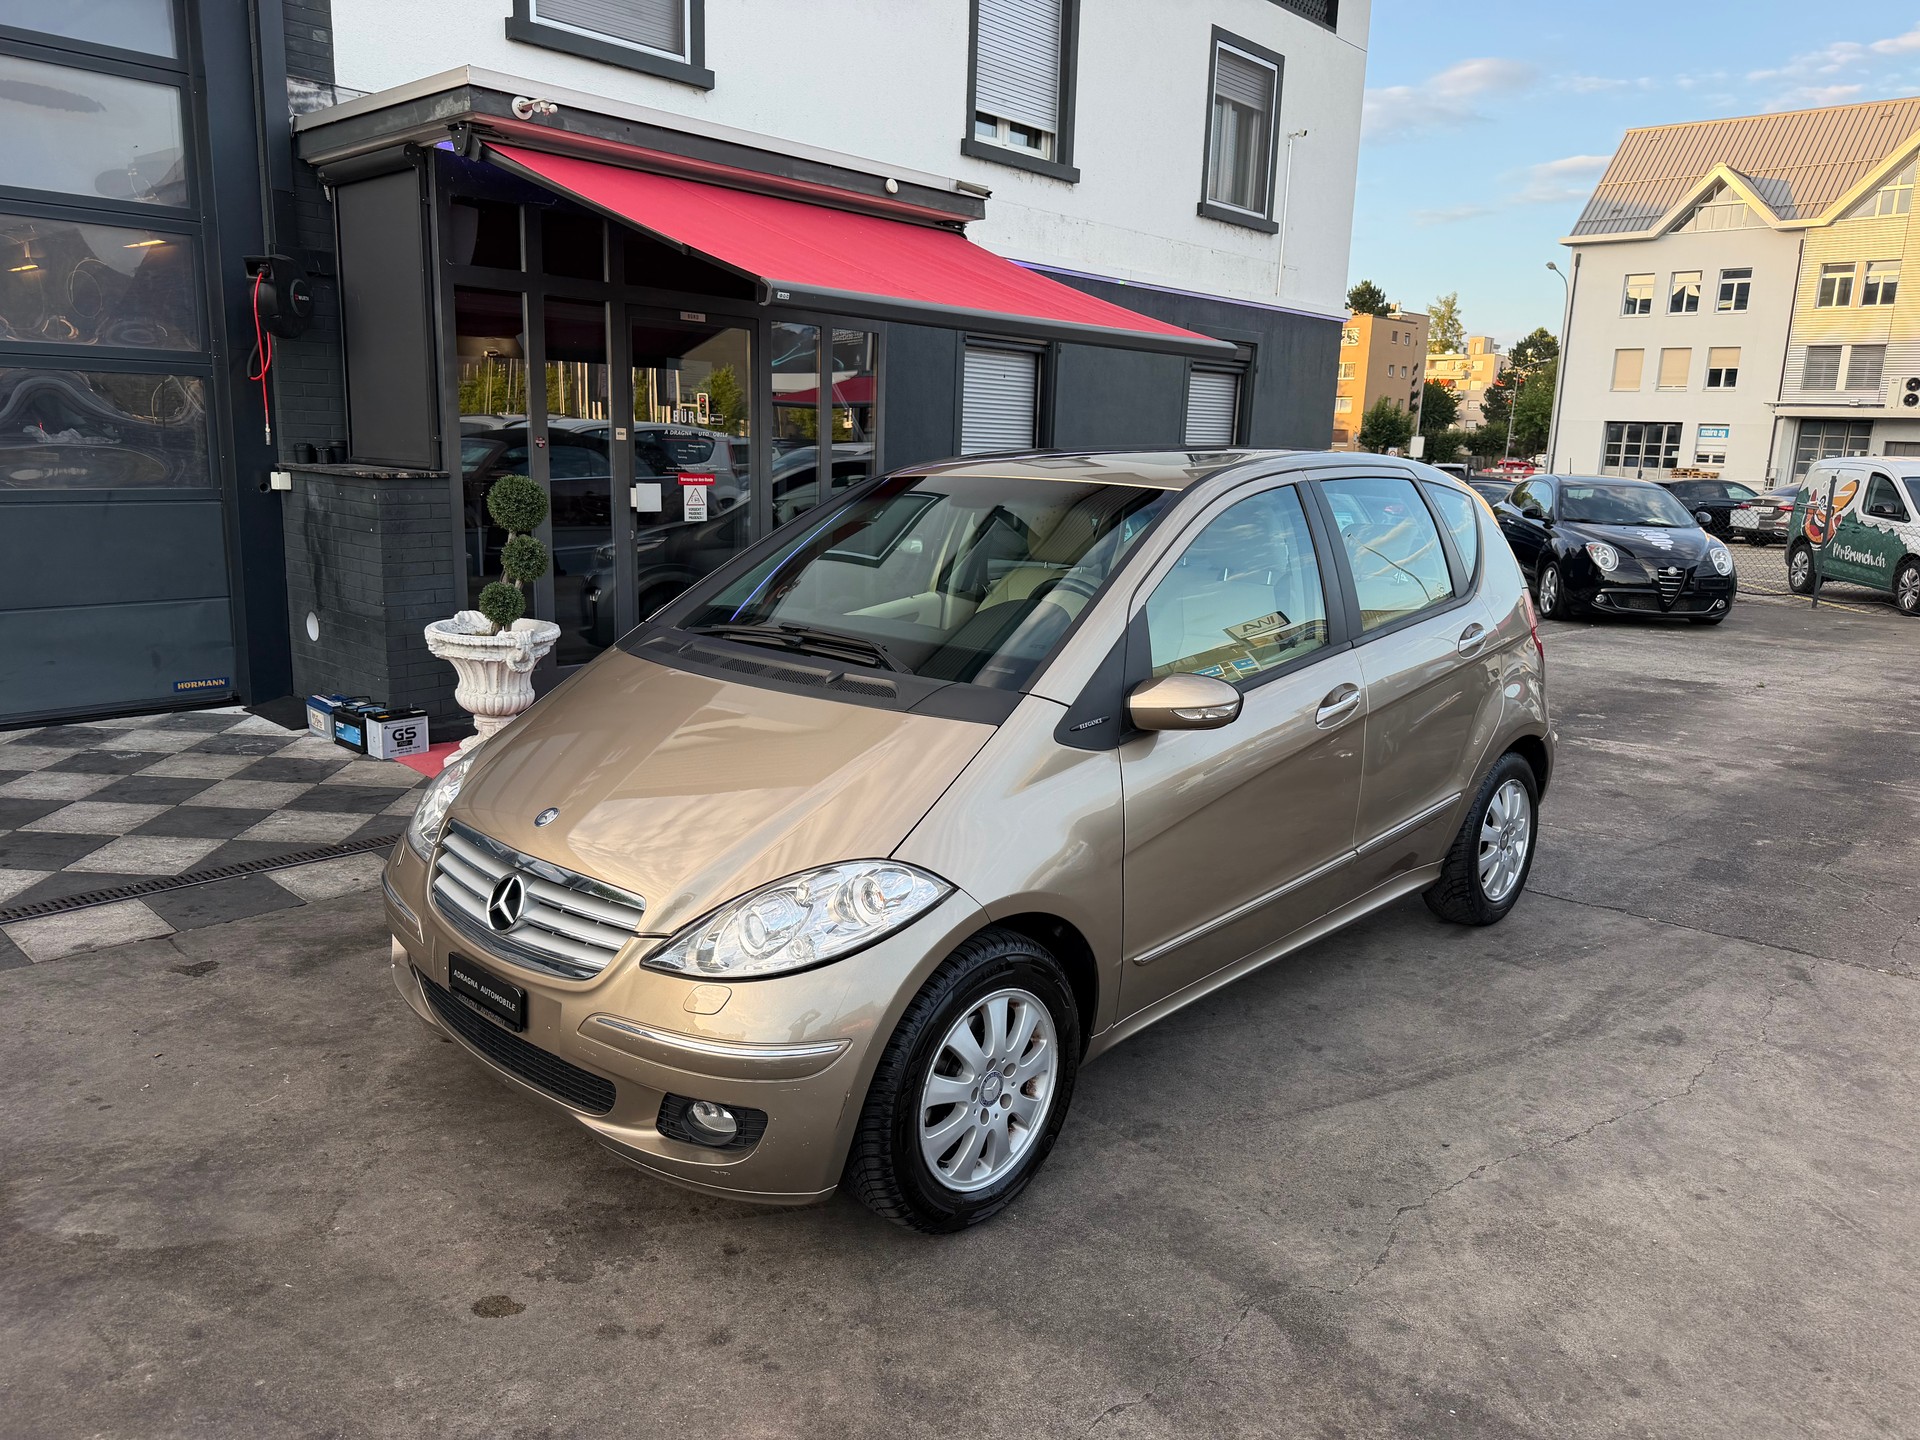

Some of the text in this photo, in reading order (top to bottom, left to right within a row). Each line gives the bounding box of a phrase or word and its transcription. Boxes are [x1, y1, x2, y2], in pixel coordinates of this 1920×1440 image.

[672, 409, 703, 424] BÜRO
[1832, 542, 1887, 568] MrBrunch.ch
[392, 726, 417, 741] GS
[453, 969, 478, 989] ADRAGNA
[480, 986, 516, 1011] AUTOMOBILE
